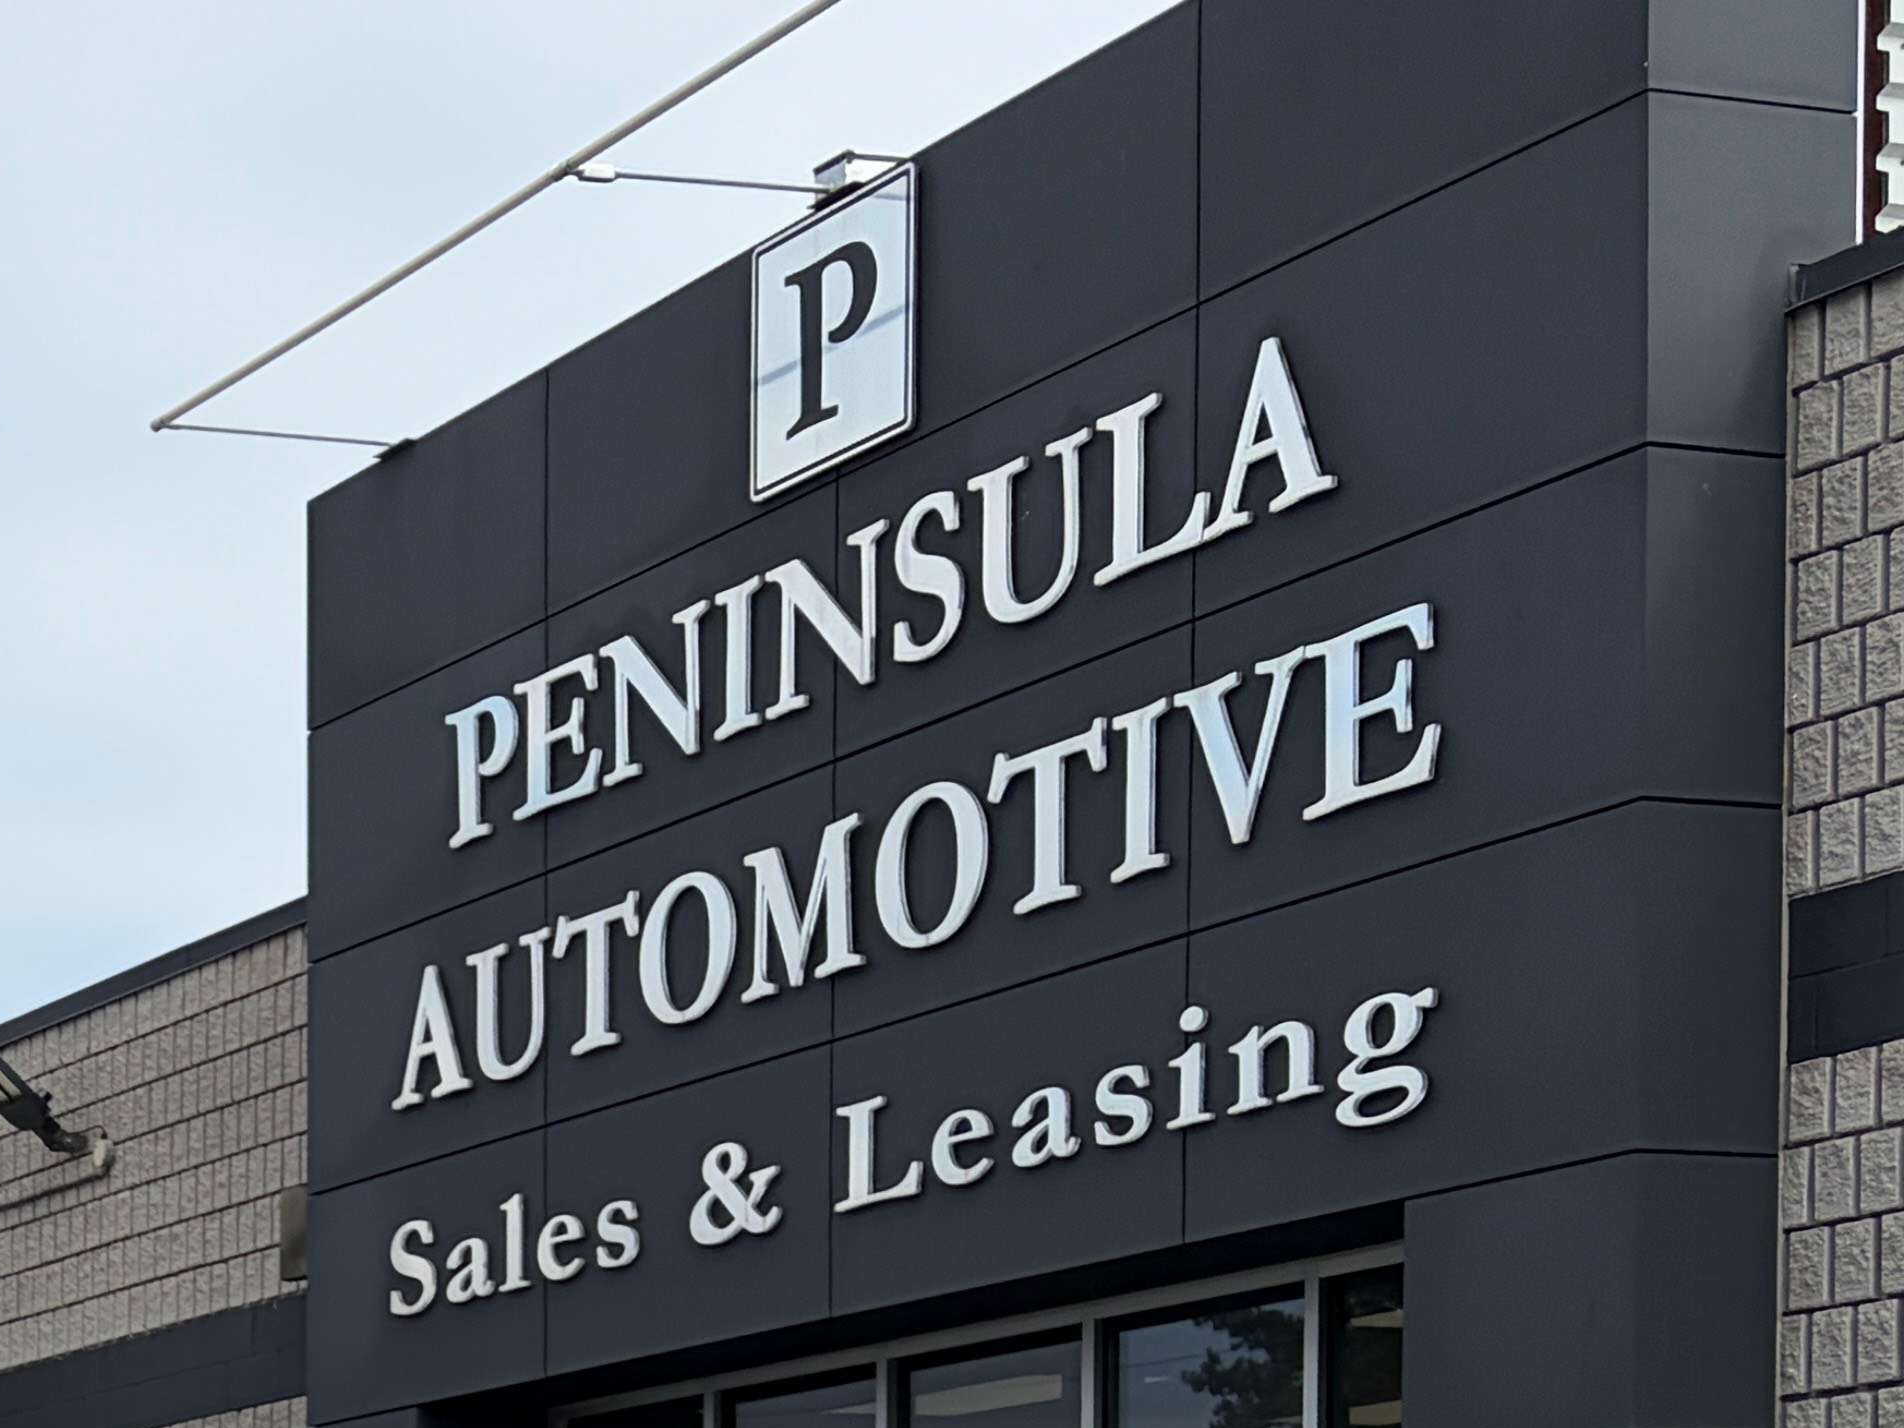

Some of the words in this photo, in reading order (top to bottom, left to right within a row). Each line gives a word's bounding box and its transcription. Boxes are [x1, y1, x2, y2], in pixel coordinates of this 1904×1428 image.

[784, 239, 880, 442] P
[444, 335, 1340, 851] PENINSULA
[391, 602, 1443, 1110] AUTOMOTIVE
[388, 1192, 643, 1318] Sales
[688, 1140, 783, 1248] &
[833, 986, 1440, 1214] Leasing
